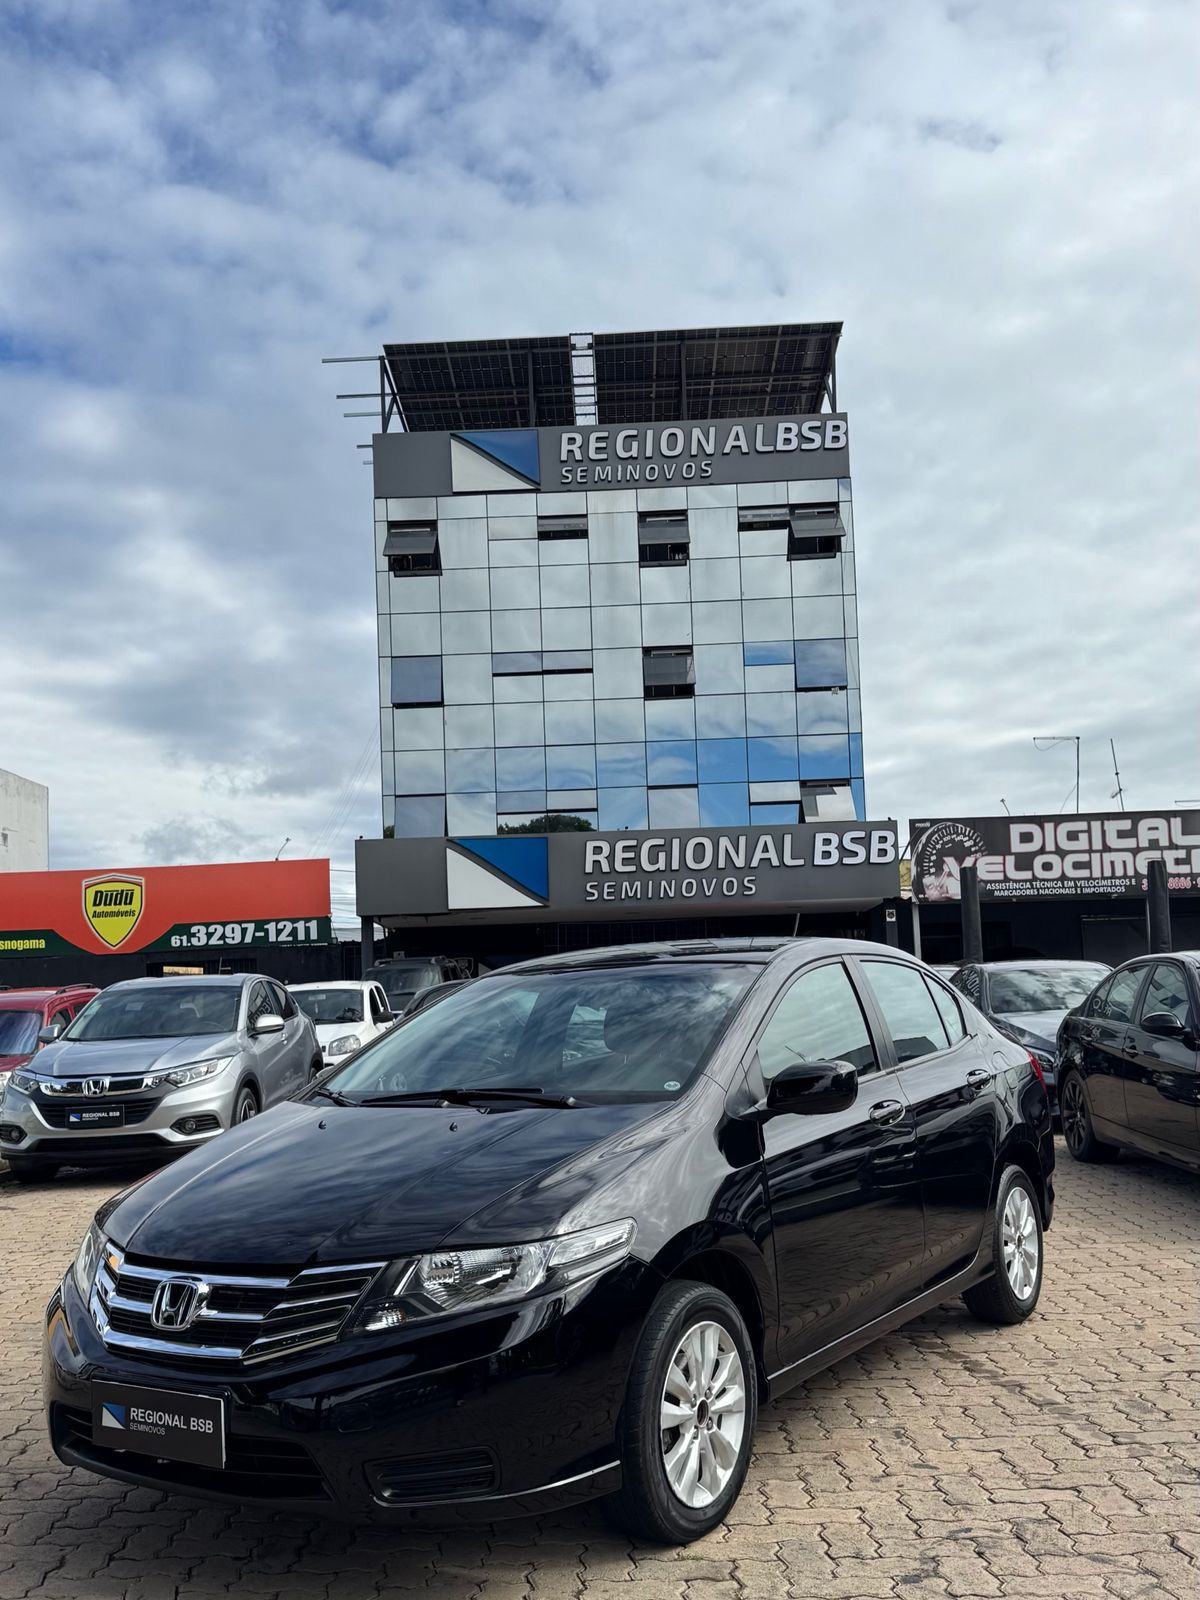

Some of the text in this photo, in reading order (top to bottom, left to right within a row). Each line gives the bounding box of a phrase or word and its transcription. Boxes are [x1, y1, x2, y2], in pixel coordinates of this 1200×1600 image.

[560, 460, 713, 484] SEMINOVOS
[1009, 816, 1200, 853] DIGITAL
[584, 834, 805, 874] REGIONAL
[813, 830, 896, 866] BSB
[585, 876, 757, 901] SEMINOVOS
[986, 880, 1031, 890] ASSISTÊNCIA
[1032, 879, 1062, 889] TÉCNICA
[1064, 880, 1075, 888] EM
[1076, 878, 1130, 888] VELOCÍMETROS
[1131, 878, 1137, 886] E
[994, 886, 1126, 897] MARCADORES NACIONAIS E IMPORTADOS
[92, 908, 136, 919] Automóveis
[0, 938, 46, 951] snogama
[129, 1422, 166, 1436] SEMINOVOS
[130, 1407, 214, 1434] REGIONAL BSB
